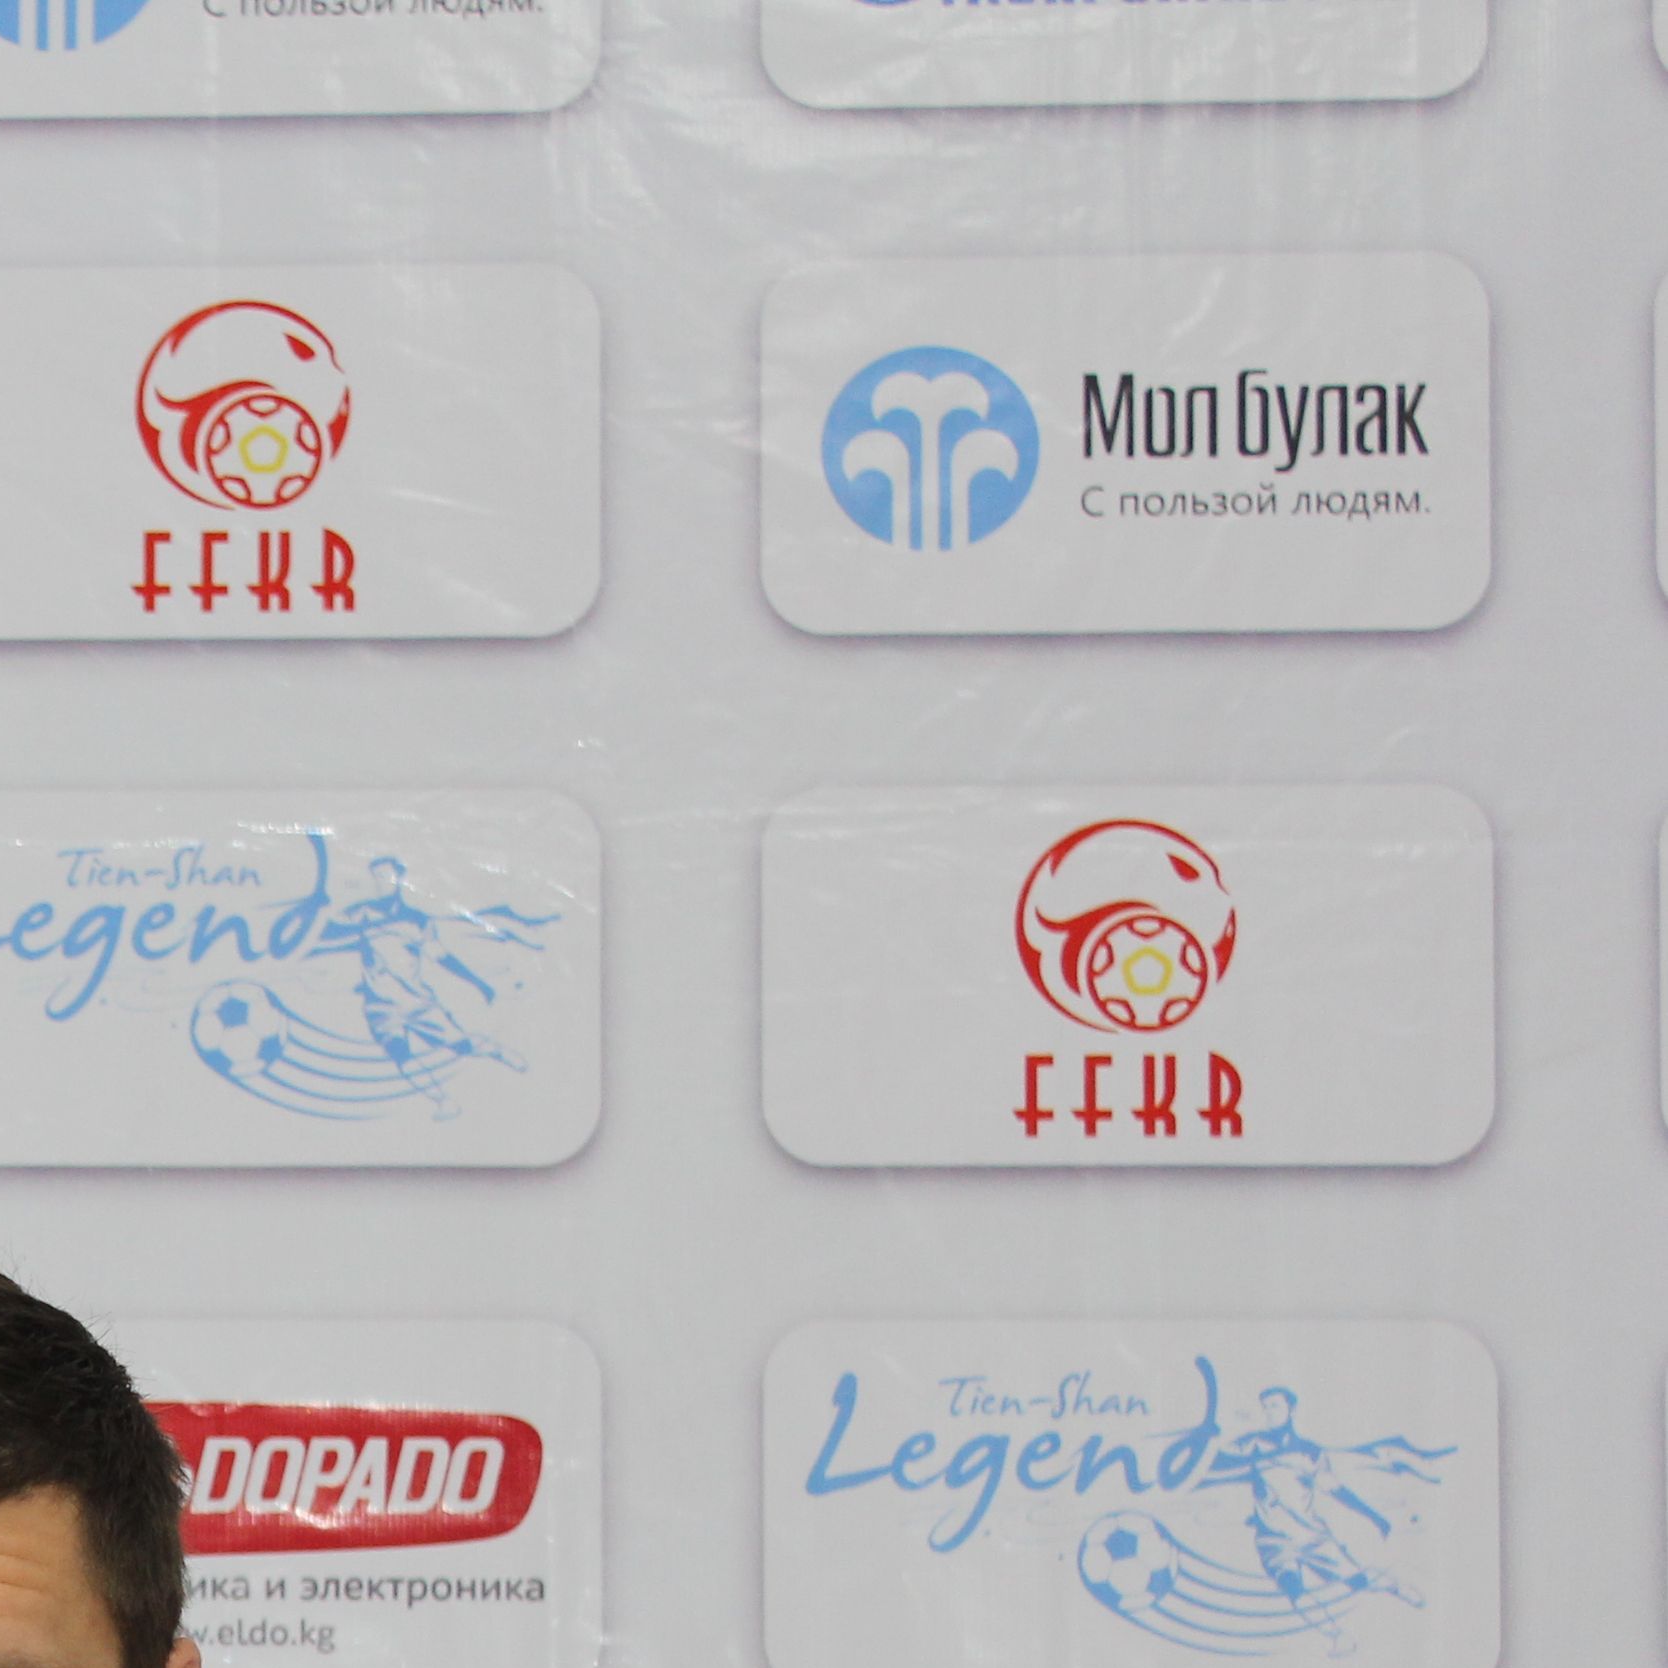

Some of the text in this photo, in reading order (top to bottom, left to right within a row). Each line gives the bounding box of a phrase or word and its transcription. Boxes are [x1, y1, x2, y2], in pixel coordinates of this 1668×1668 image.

[1082, 373, 1218, 458] Мол
[1080, 482, 1431, 521] С пользой людям.
[133, 529, 356, 613] FFKR
[57, 845, 262, 891] Tien-Shan
[1014, 1052, 1244, 1138] FFKR
[938, 1370, 1150, 1419] Tien-Shan
[805, 1355, 1220, 1554] Legend
[265, 1578, 287, 1600] и
[300, 1576, 546, 1609] электроника
[185, 1618, 336, 1655] w.eldo.kg
